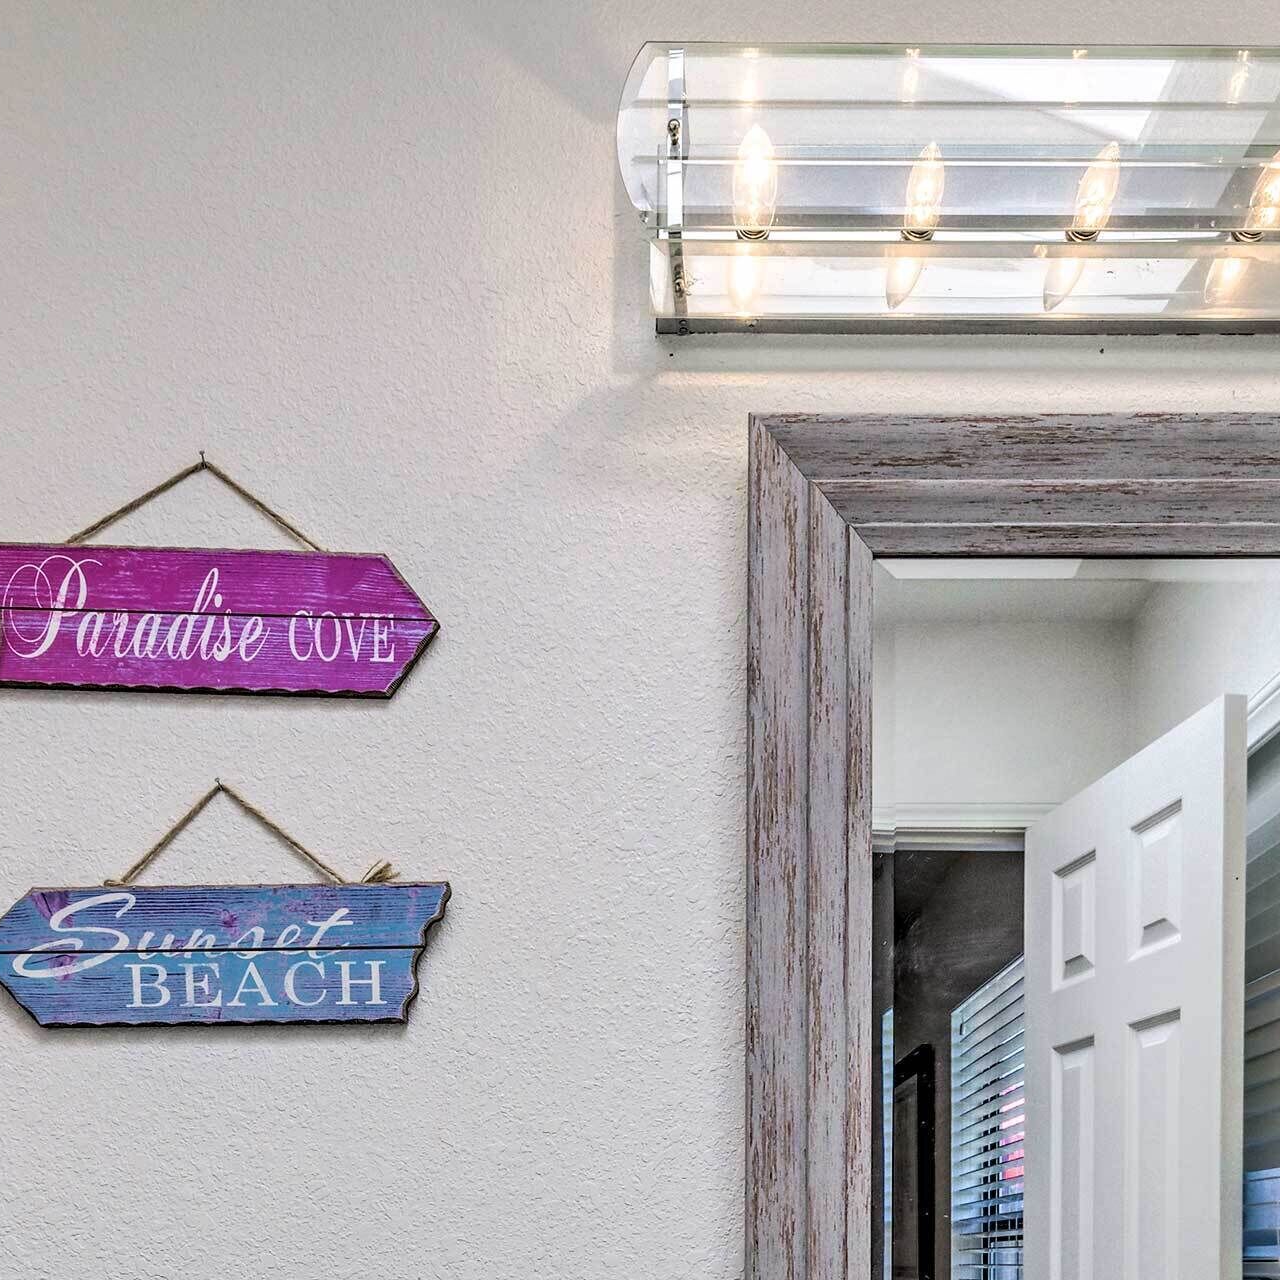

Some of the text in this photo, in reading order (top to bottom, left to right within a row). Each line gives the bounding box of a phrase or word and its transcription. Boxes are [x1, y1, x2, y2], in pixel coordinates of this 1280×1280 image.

[2, 555, 395, 663] Paradise COVE
[12, 892, 353, 978] Sunset
[126, 960, 387, 1009] BEACH
